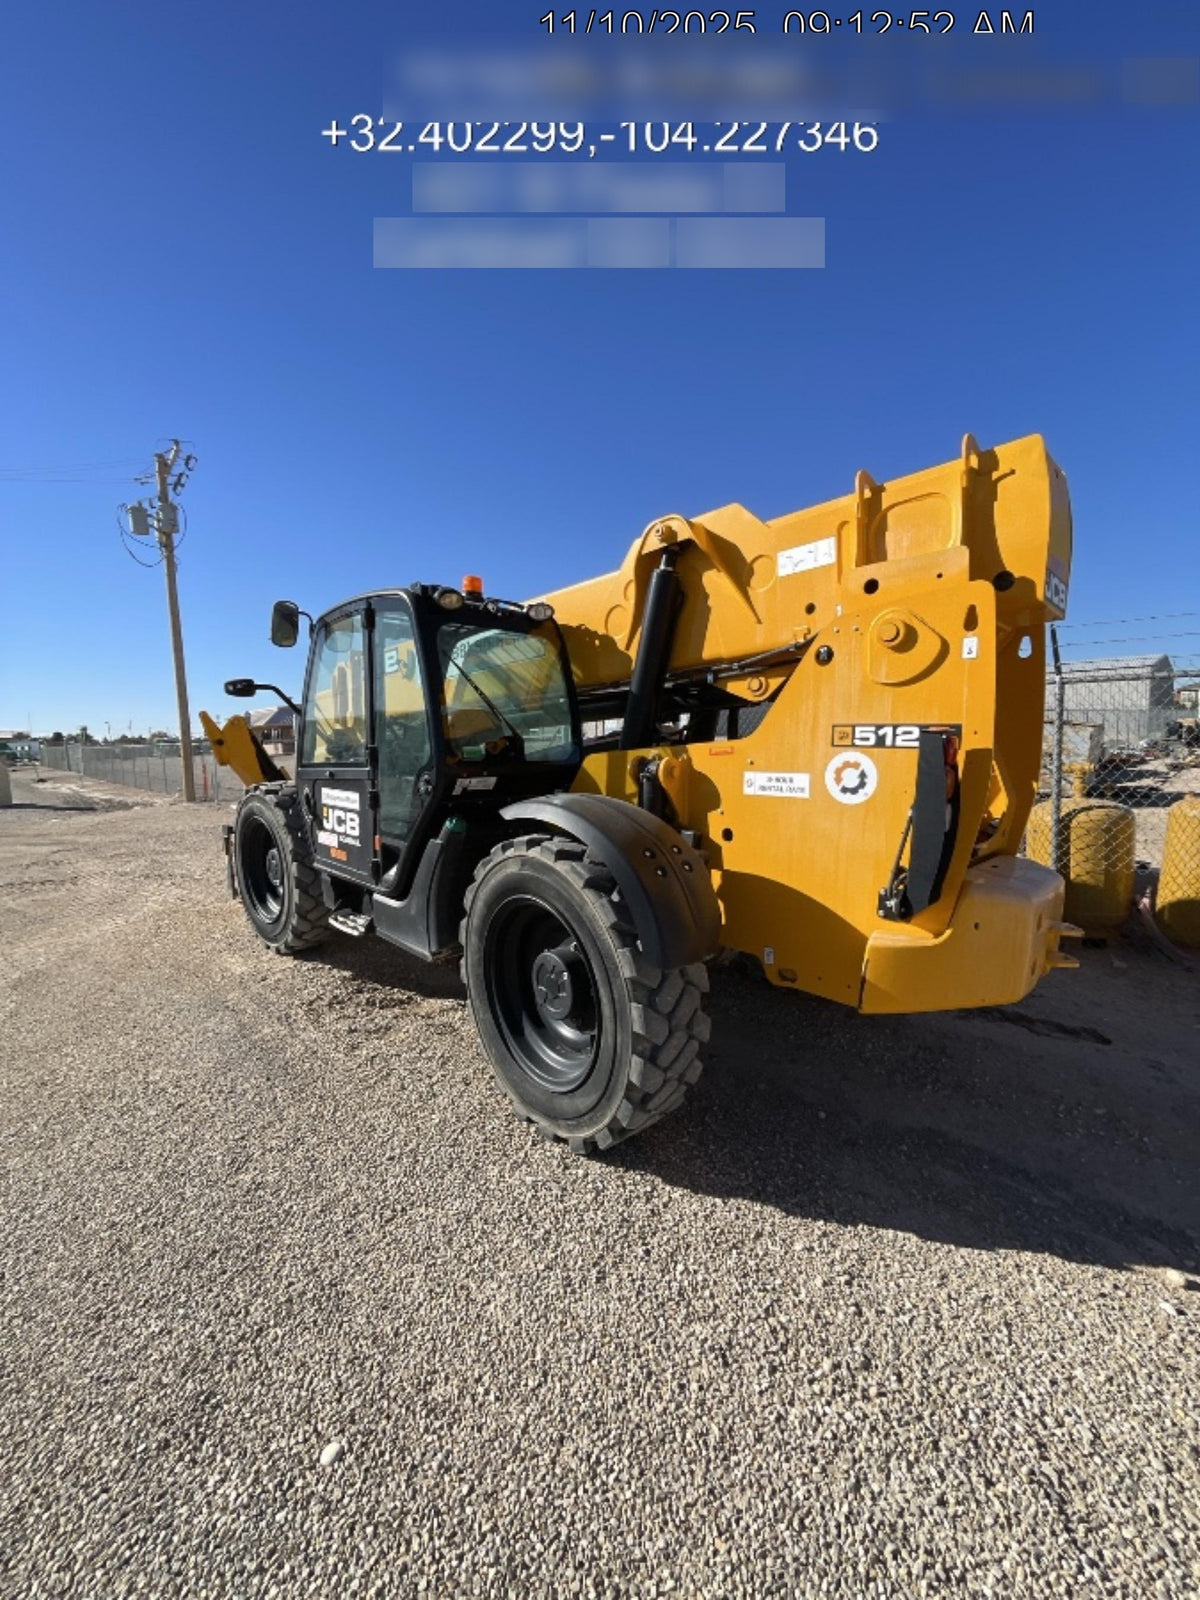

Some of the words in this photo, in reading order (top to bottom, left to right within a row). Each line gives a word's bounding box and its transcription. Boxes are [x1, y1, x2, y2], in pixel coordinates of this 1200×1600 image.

[1045, 572, 1067, 610] JCB
[853, 726, 920, 748] 512
[322, 806, 360, 836] JCB
